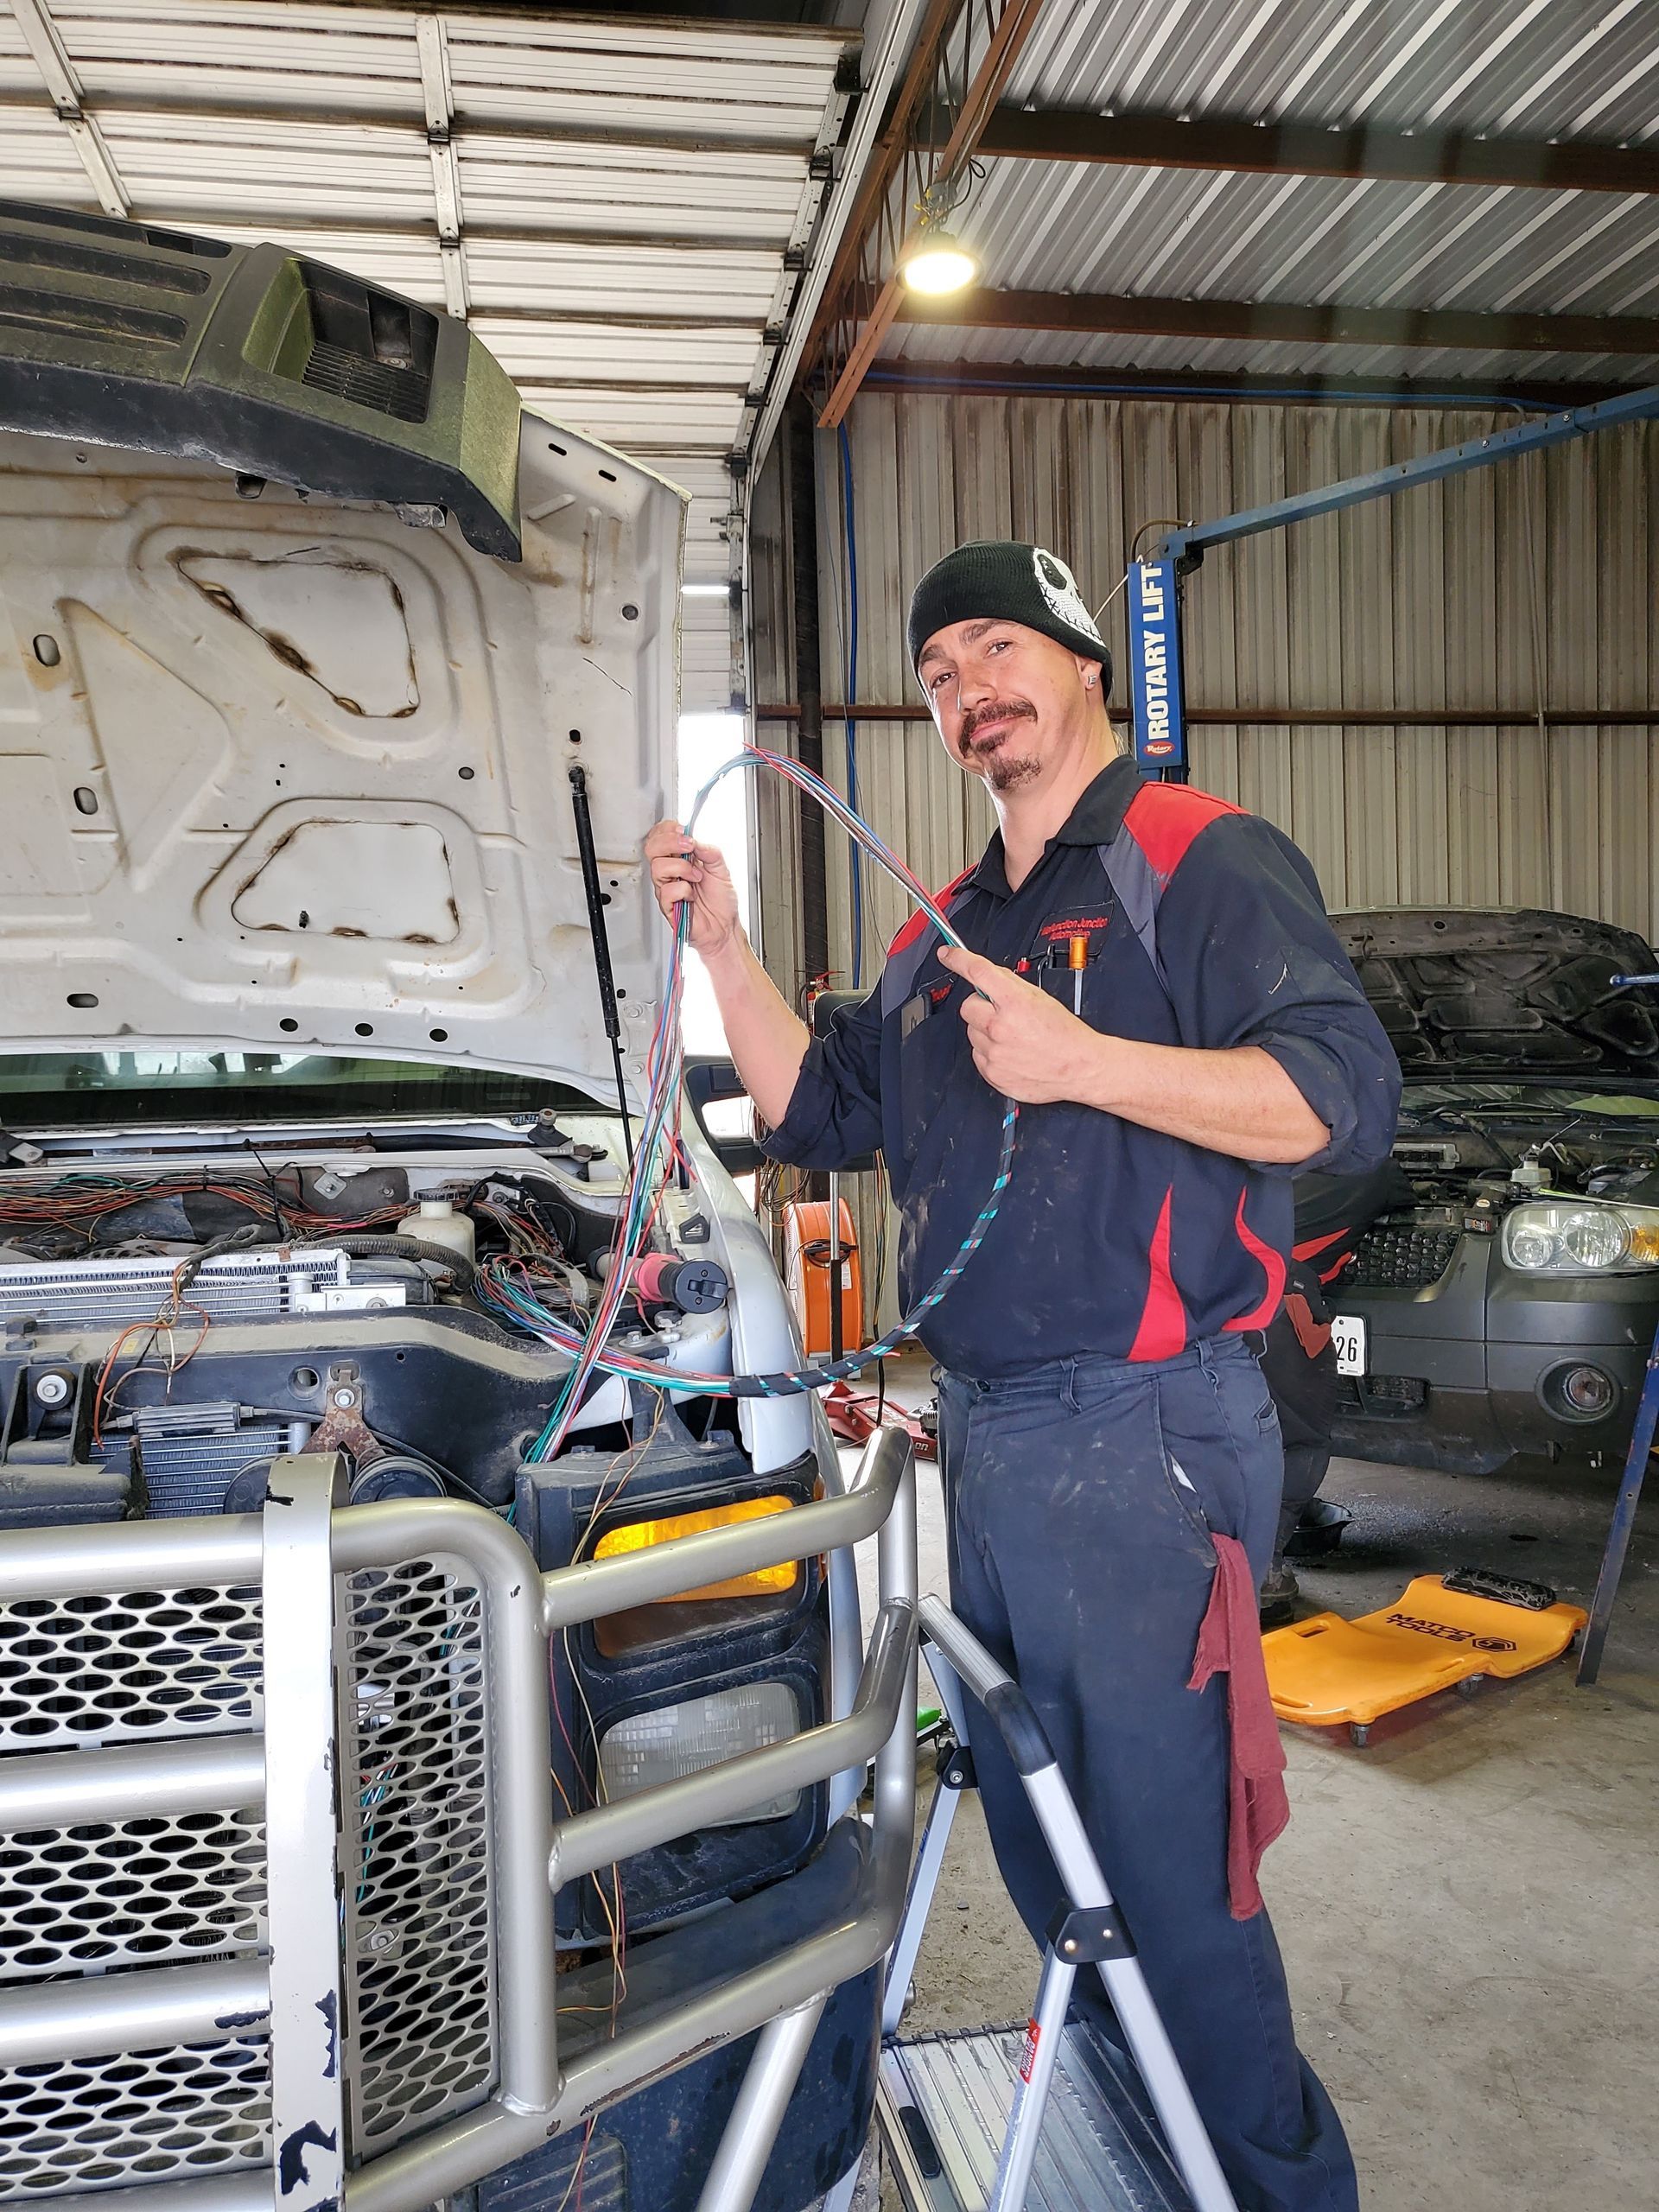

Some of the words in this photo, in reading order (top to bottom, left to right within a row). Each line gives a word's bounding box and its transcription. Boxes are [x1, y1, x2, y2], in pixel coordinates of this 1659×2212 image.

[1141, 564, 1165, 622] LIFT
[1143, 630, 1170, 740] ROTARY
[1147, 745, 1173, 754] Rotary
[1336, 1336, 1357, 1362] 26
[1386, 1617, 1466, 1642] TOOLS
[1388, 1613, 1476, 1637] MATCO
